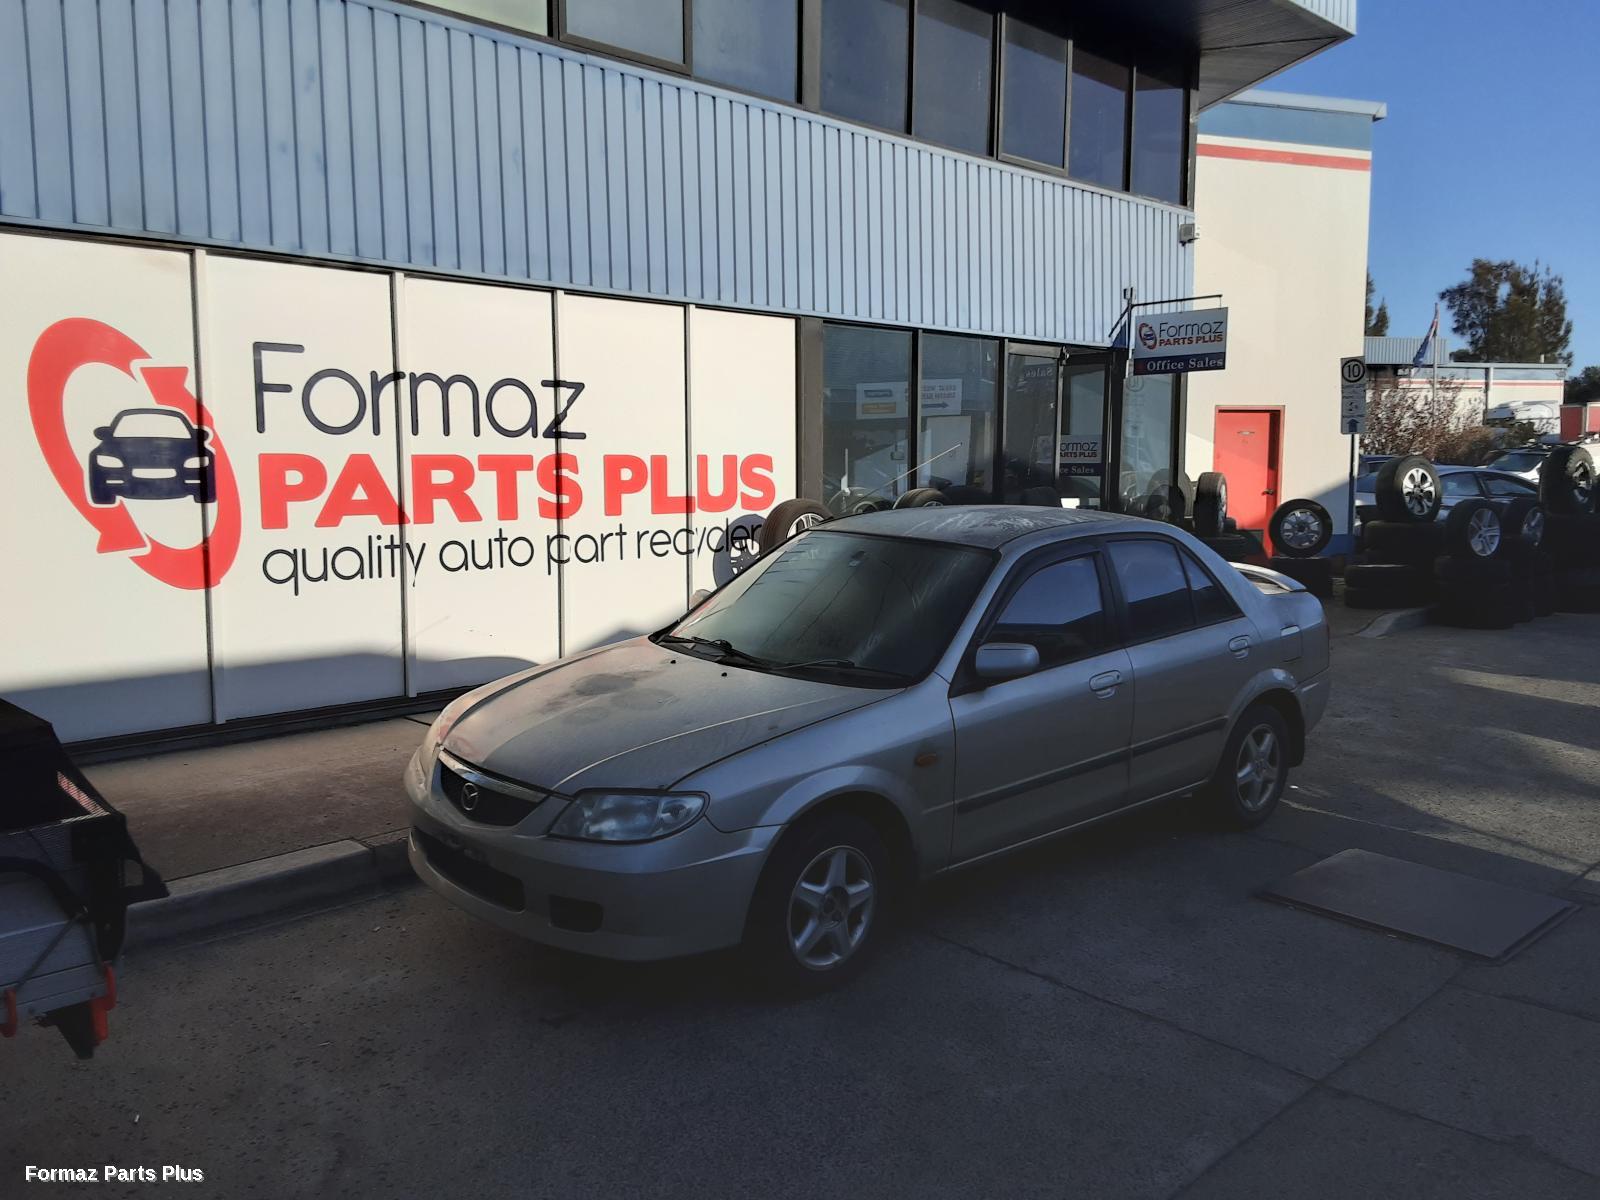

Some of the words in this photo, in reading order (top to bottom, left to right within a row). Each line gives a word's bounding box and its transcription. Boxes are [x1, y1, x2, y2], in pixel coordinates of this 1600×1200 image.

[1159, 321, 1224, 338] Formaz
[1159, 338, 1194, 347] PARTS
[1196, 334, 1224, 344] PLUS
[1146, 360, 1184, 371] Office
[1188, 357, 1224, 369] Sales
[1346, 363, 1360, 378] 10
[252, 341, 586, 439] Formaz
[1059, 441, 1098, 452] ormaz
[258, 453, 584, 530] PARTS
[603, 453, 776, 517] PLUS
[262, 533, 426, 596] quality
[438, 528, 535, 572] auto
[547, 523, 628, 576] part
[637, 517, 762, 560] recycler
